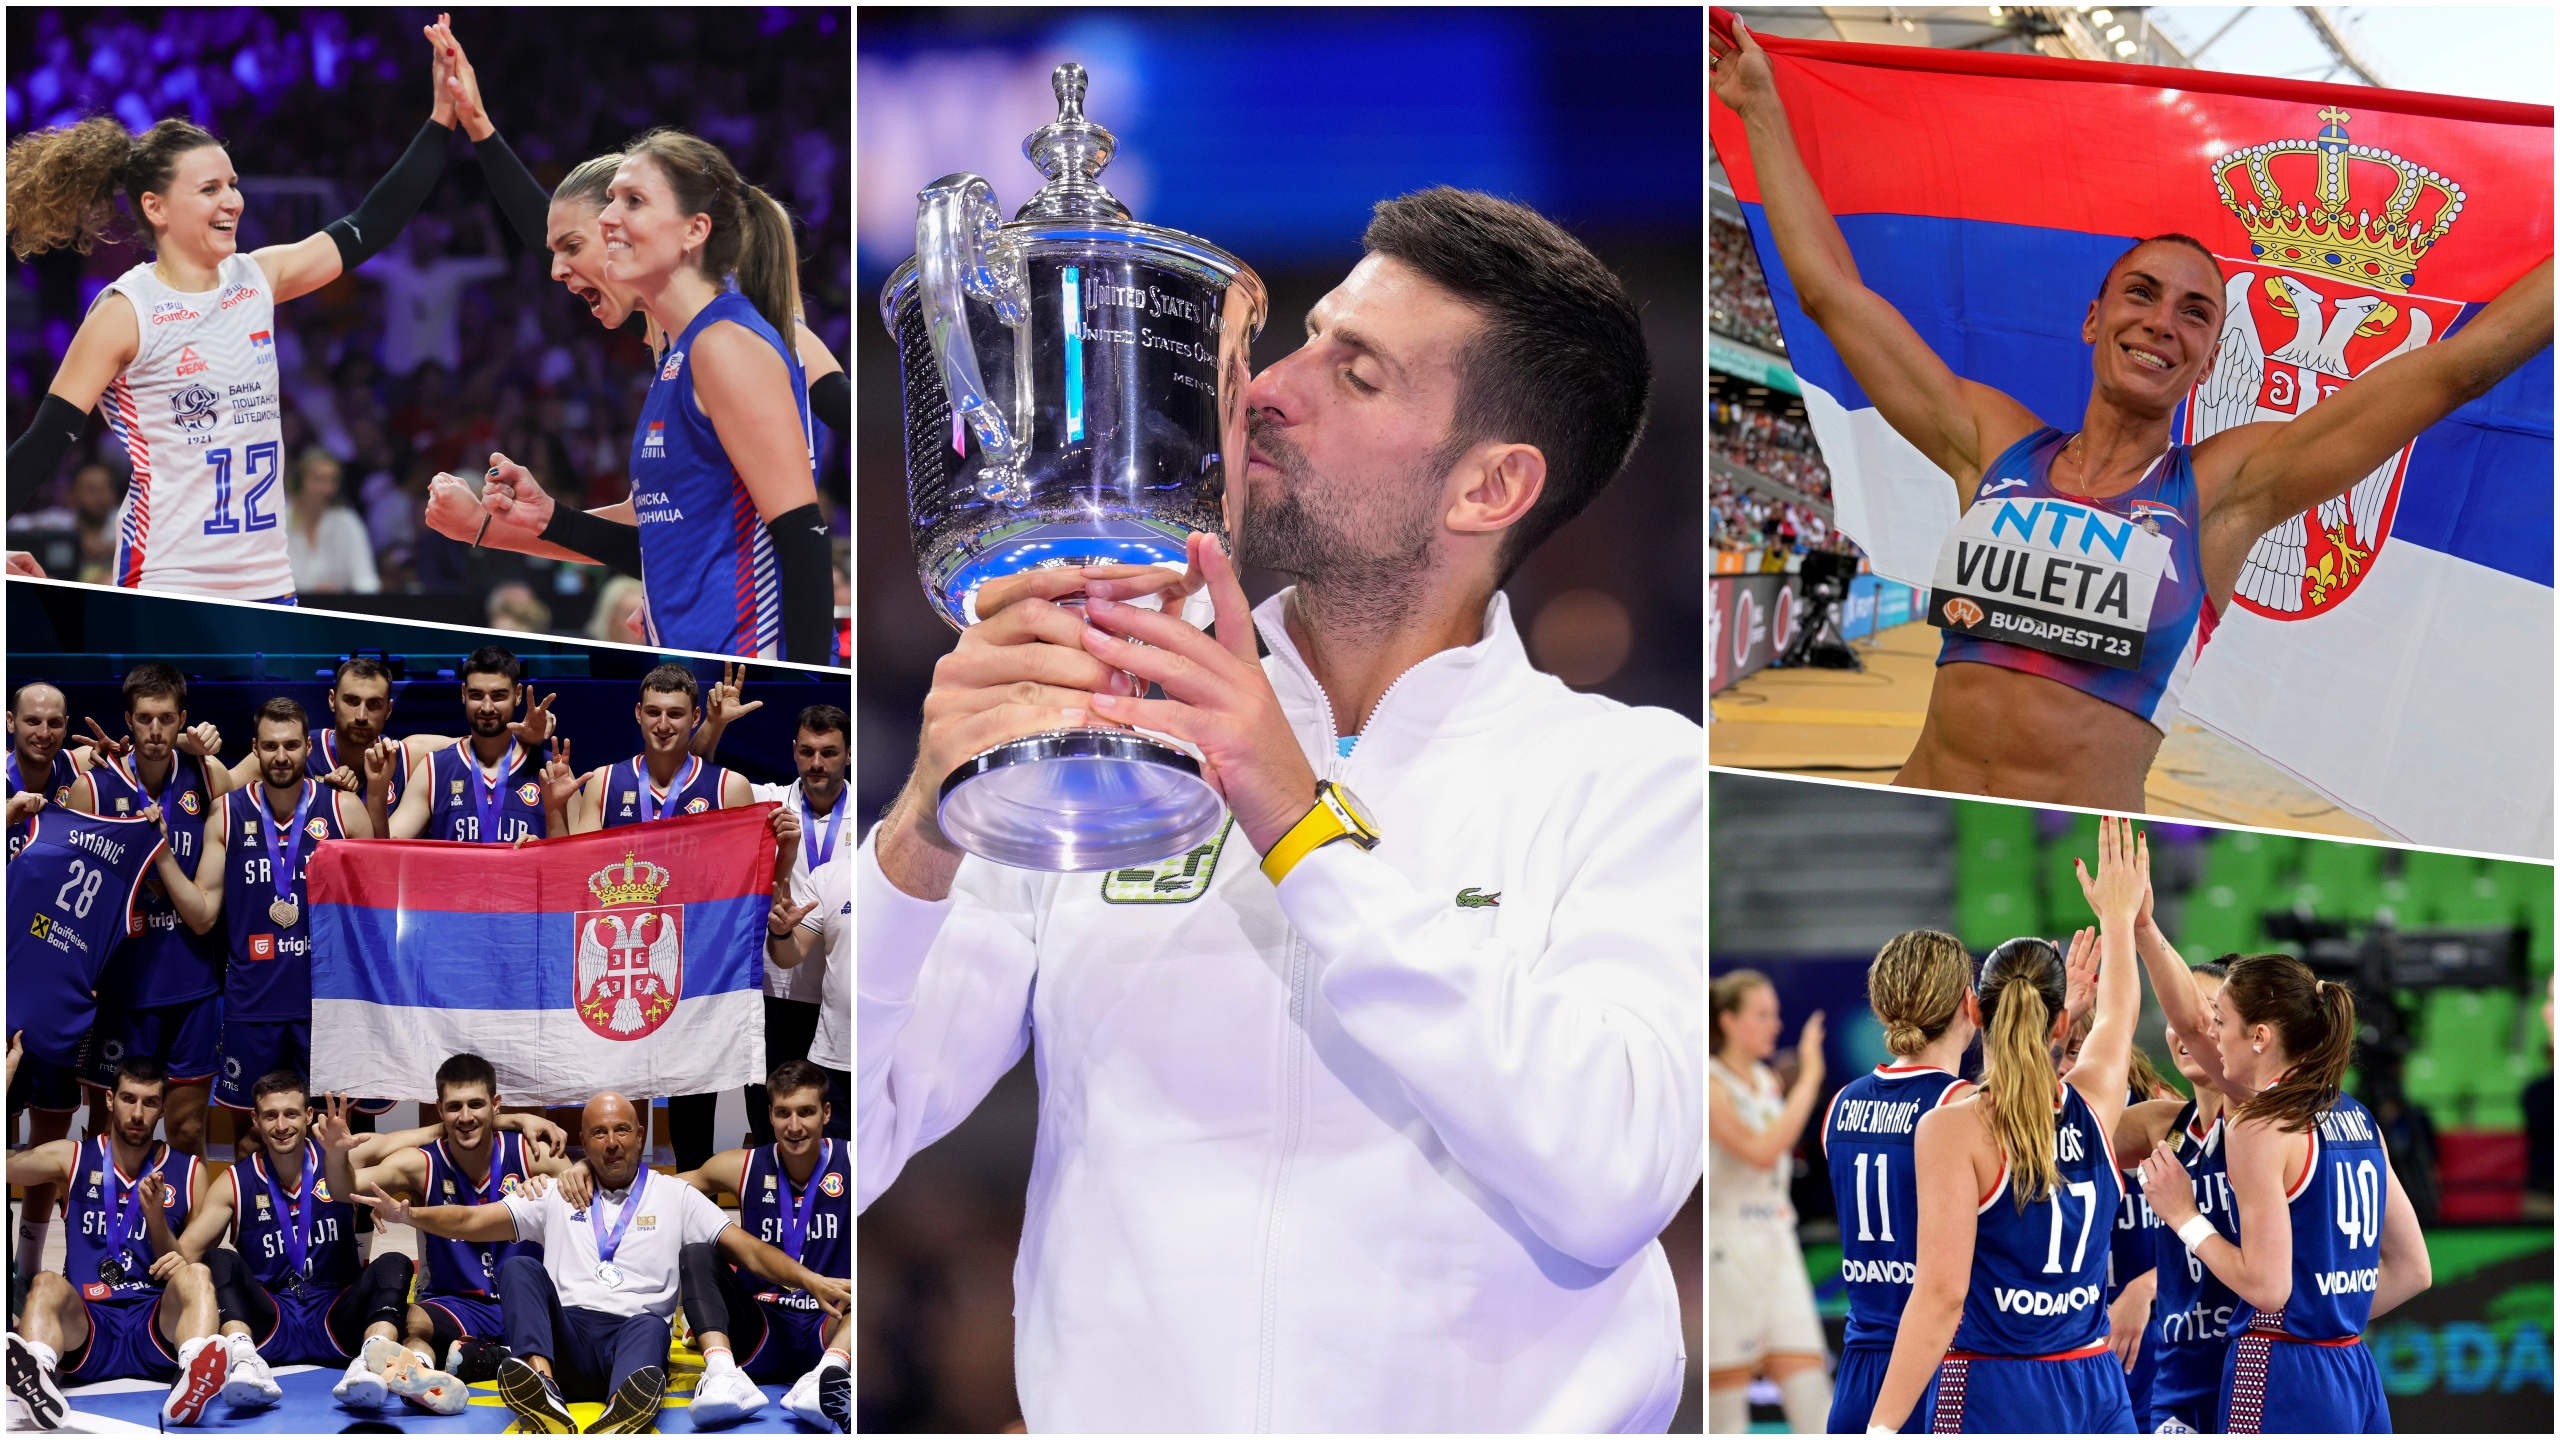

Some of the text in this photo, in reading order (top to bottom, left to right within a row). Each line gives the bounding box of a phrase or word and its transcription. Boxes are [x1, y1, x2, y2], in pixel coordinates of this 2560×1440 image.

[1085, 277, 1146, 310] UNITED
[1149, 285, 1200, 318] STATES
[1075, 321, 1135, 345] UNITED
[1141, 327, 1192, 358] STATES
[176, 360, 209, 377] PEAK
[229, 381, 262, 396] БАНКА
[1173, 372, 1215, 396] MEN'S
[187, 435, 212, 445] 1921
[641, 447, 666, 459] SERBIA
[204, 441, 278, 535] 12
[1991, 500, 2134, 563] NTN
[1956, 541, 2129, 620] VULETA
[1989, 611, 2132, 657] BUDAPEST 23
[68, 829, 125, 865] SIMANIĆ
[55, 859, 103, 919] 28
[47, 932, 70, 953] Bank
[51, 920, 88, 953] Raiffeisen
[1854, 1153, 1895, 1242] 11
[2336, 1160, 2379, 1250] 40
[2041, 1180, 2097, 1274] 17
[2163, 1301, 2234, 1343] mts
